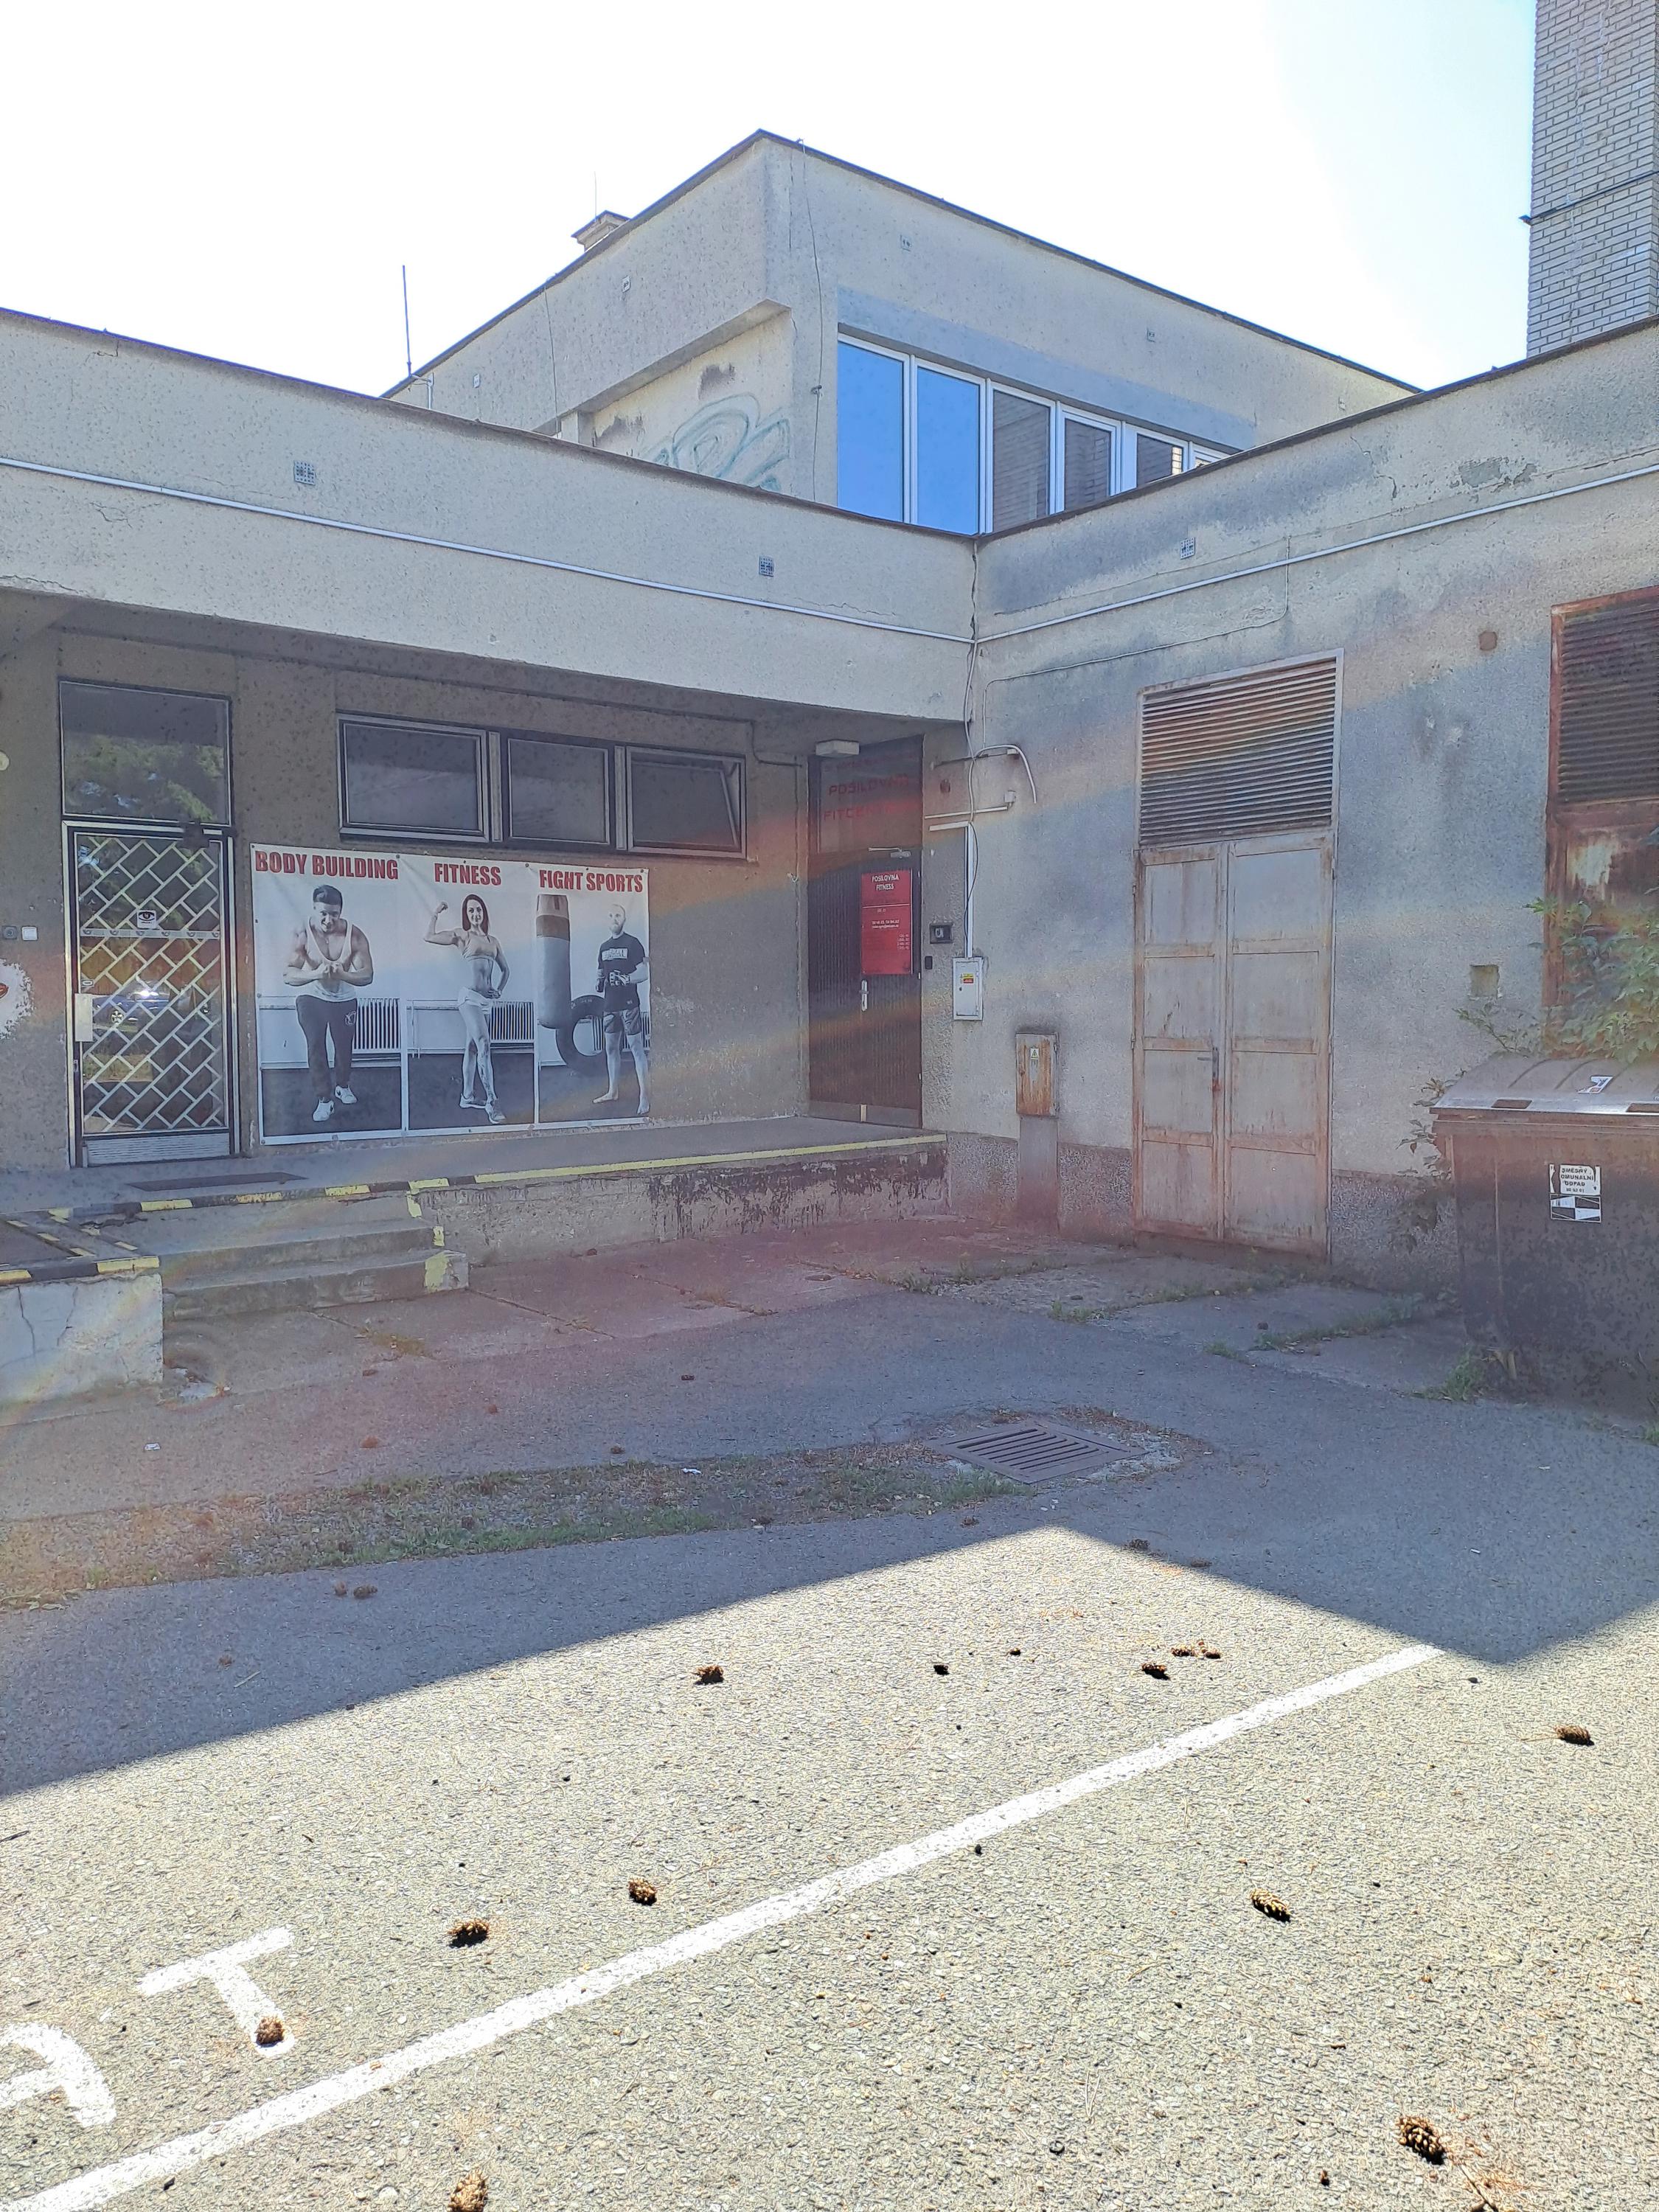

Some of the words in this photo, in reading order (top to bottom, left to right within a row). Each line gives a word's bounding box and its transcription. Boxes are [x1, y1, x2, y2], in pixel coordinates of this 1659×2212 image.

[255, 850, 307, 874] BODY
[312, 855, 399, 880] BUILDING
[434, 863, 501, 886] FITNESS
[539, 869, 583, 891] FIGHT
[586, 873, 643, 893] SPORTS
